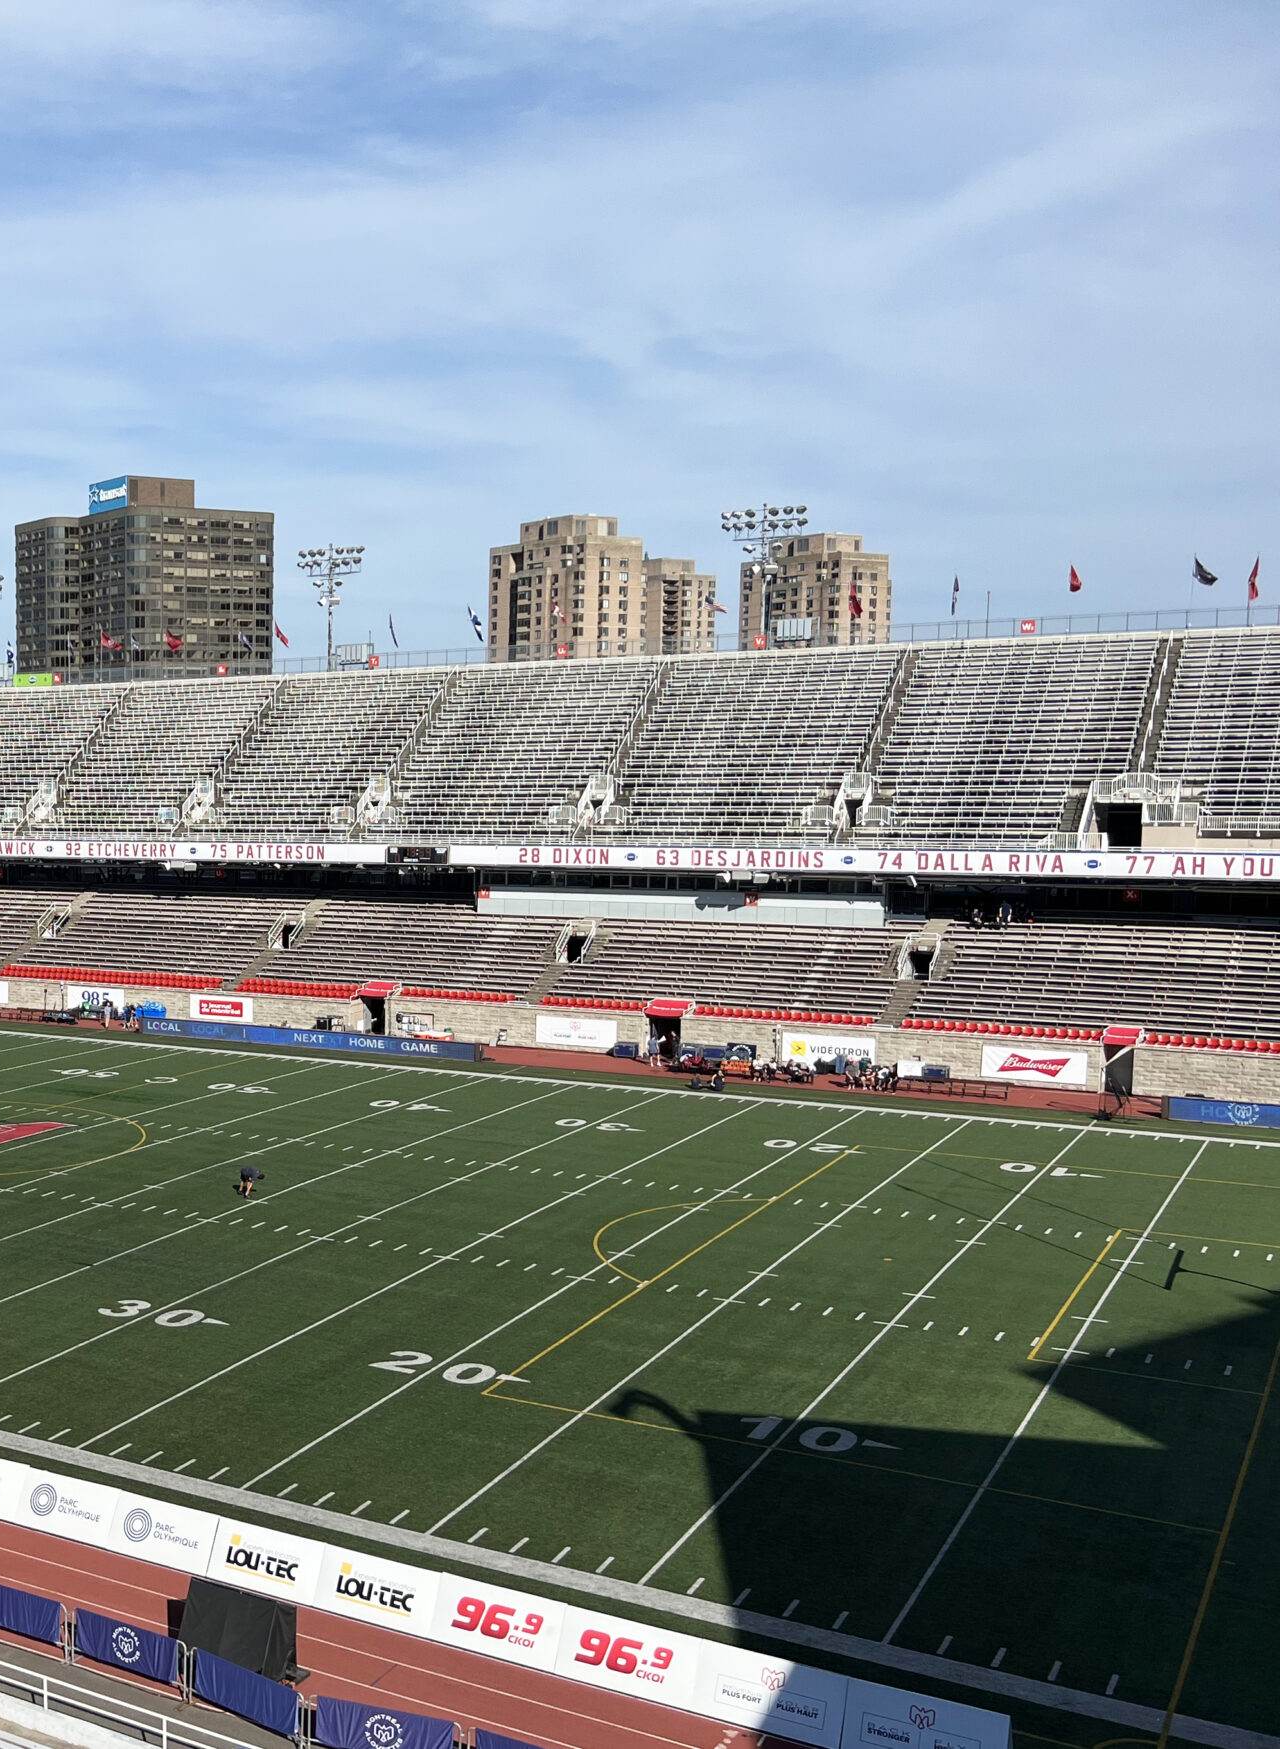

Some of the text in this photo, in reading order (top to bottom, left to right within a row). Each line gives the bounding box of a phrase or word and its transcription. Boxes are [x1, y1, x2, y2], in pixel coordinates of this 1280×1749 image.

[65, 843, 177, 857] 92 ETCHEVERRY
[211, 844, 325, 860] 75 PATTERSON
[519, 848, 609, 865] 28 DIXON
[657, 850, 824, 868] 63 DESJARDINS
[878, 852, 1064, 873] 74 DALLA RIVA
[1126, 855, 1274, 876] 77 AH YOU
[148, 1021, 181, 1032] LOCAL
[294, 1033, 324, 1043] NEXT
[349, 1037, 385, 1049] HOME
[401, 1042, 438, 1053] GAME
[810, 1045, 870, 1057] VIDEOTRON
[1005, 1056, 1064, 1071] Budweiser
[98, 1299, 206, 1327] 30
[369, 1351, 497, 1384] 20
[739, 1416, 859, 1452] 10
[60, 1496, 79, 1509] PARC
[58, 1505, 101, 1523] OLYMPIQUE
[155, 1521, 176, 1534] PARC
[153, 1531, 200, 1550] OLYMPIQUE
[451, 1596, 544, 1640] 96.9
[111, 1625, 140, 1647] MONTREAL
[508, 1634, 535, 1649] CKOI
[111, 1642, 141, 1664] ALOUETTES
[574, 1629, 674, 1674] 96.9
[635, 1669, 666, 1684] CKOI
[722, 1688, 762, 1704] PLUS FORT
[776, 1703, 819, 1720] PLUS HAUT
[364, 1713, 403, 1735] MONTREAL
[866, 1728, 911, 1744] STRONGER
